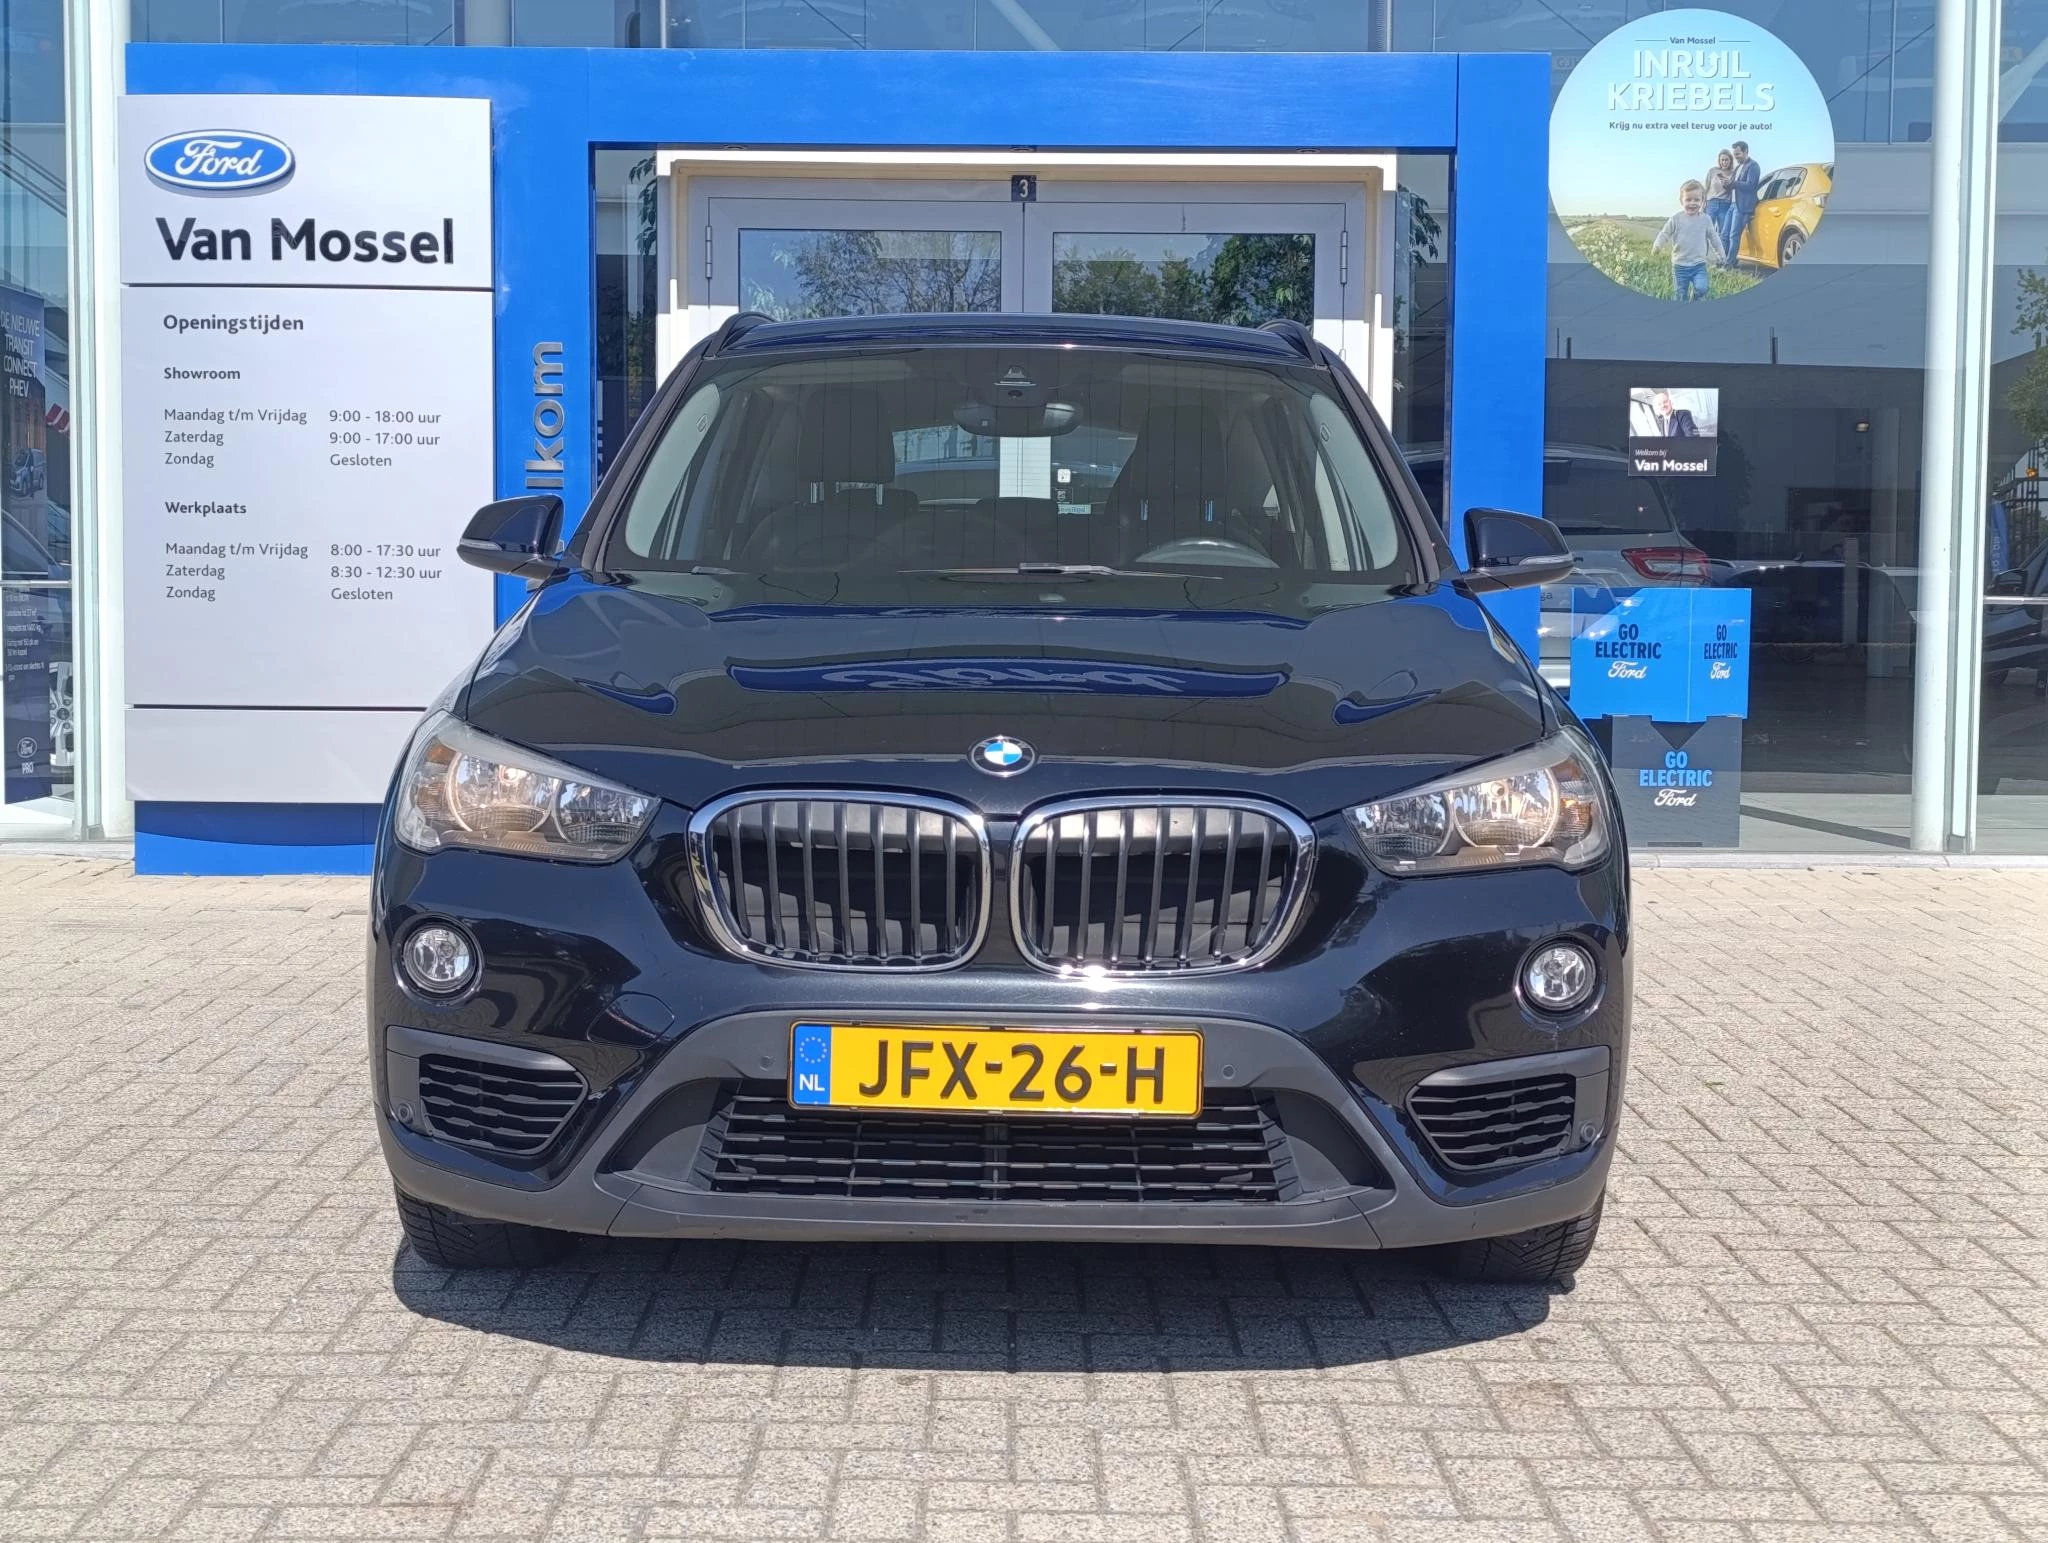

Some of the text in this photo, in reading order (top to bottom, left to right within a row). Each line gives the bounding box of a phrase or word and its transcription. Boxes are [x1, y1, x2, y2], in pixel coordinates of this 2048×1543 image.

[1669, 36, 1716, 45] Van Mossel
[1633, 49, 1752, 79] INRUIL
[1607, 82, 1776, 111] KRIEBELS
[1608, 121, 1630, 132] Krijg
[1645, 121, 1669, 130] extra
[1670, 121, 1690, 130] veel
[1691, 122, 1716, 132] terug
[1717, 123, 1738, 131] voor
[1738, 121, 1748, 132] je
[1749, 122, 1773, 131] auto!
[174, 138, 262, 178] Ford
[1019, 179, 1029, 198] 3
[155, 217, 454, 265] Van Mossel
[1, 310, 41, 337] DE NIEUWE
[163, 313, 304, 335] Openingstijden
[5, 333, 35, 357] TRANSIT
[4, 355, 38, 378] CONNECT
[163, 366, 241, 380] Showroom
[9, 377, 29, 398] PHEV
[164, 407, 225, 425] Maandag
[228, 408, 254, 422] t/m
[257, 408, 308, 426] Vrijdag
[329, 409, 361, 423] 9:00
[374, 410, 414, 423] 18:00
[417, 414, 442, 424] uur
[164, 429, 225, 447] Zaterdag
[329, 431, 362, 445] 9:00
[375, 432, 413, 445] 17:00
[416, 436, 441, 446] uur
[164, 451, 392, 469] Zondag Gesloten
[1634, 458, 1708, 471] Van Mossel
[164, 500, 247, 518] Werkplaats
[165, 542, 226, 559] Maandag
[229, 542, 255, 556] t/m
[258, 543, 309, 560] Vrijdag
[330, 543, 363, 557] 8:00
[376, 544, 414, 557] 17:30
[417, 547, 441, 558] uur
[165, 563, 226, 581] Zaterdag
[330, 565, 363, 578] 8:30
[375, 566, 416, 579] 12:30
[419, 569, 443, 579] uur
[166, 585, 393, 603] Zondag Gesloten
[1618, 623, 1639, 641] GO
[1716, 624, 1727, 641] GO
[1595, 641, 1662, 660] ELECTRIC
[1704, 642, 1739, 660] ELECTRIC
[1607, 660, 1648, 680] Ford
[1710, 661, 1731, 680] Ford
[1664, 750, 1688, 769] GO
[1639, 769, 1713, 787] ELECTRIC
[1654, 788, 1698, 807] Ford
[857, 1038, 1166, 1104] JFX-26-H
[799, 1072, 826, 1093] NL
